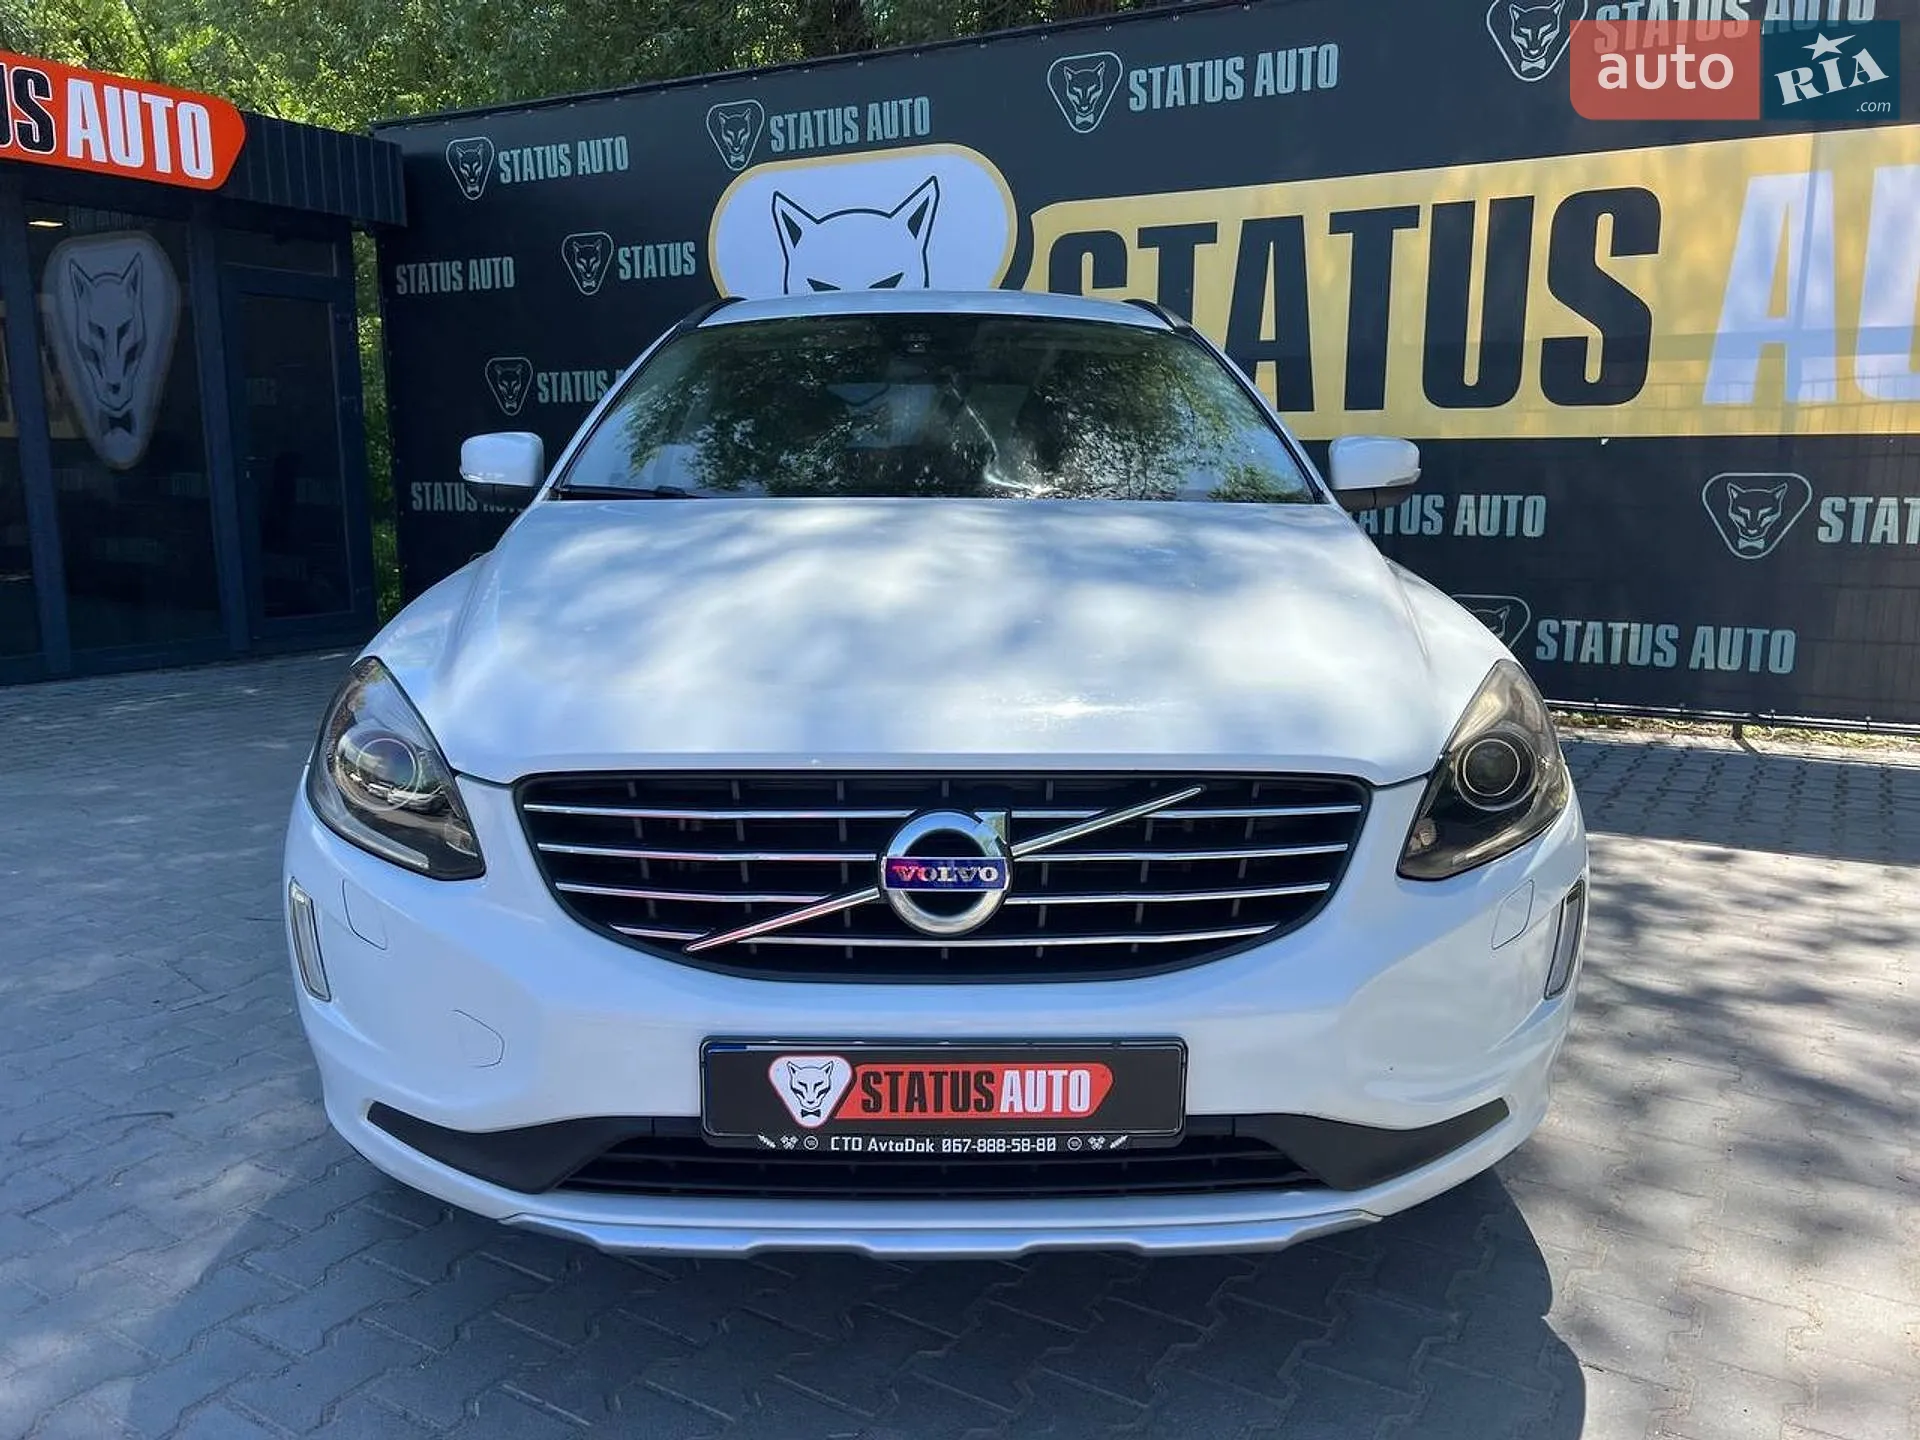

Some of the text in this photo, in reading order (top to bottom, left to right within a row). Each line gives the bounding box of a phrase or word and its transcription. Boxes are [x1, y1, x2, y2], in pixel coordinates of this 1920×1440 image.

[1128, 43, 1339, 112] STATUS AUTO
[67, 78, 214, 180] AUTO
[769, 96, 931, 153] STATUS AUTO
[498, 135, 630, 184] STATUS AUTO
[395, 256, 516, 295] STATUS AUTO
[617, 241, 696, 281] STATUS
[536, 369, 609, 404] STATUS
[1453, 494, 1547, 538] AUTO
[1536, 618, 1797, 675] STATUS AUTO
[892, 864, 999, 882] VOLVO
[861, 1069, 1091, 1114] STATUS AUTO
[941, 1137, 1057, 1153] 067-888-58-80
